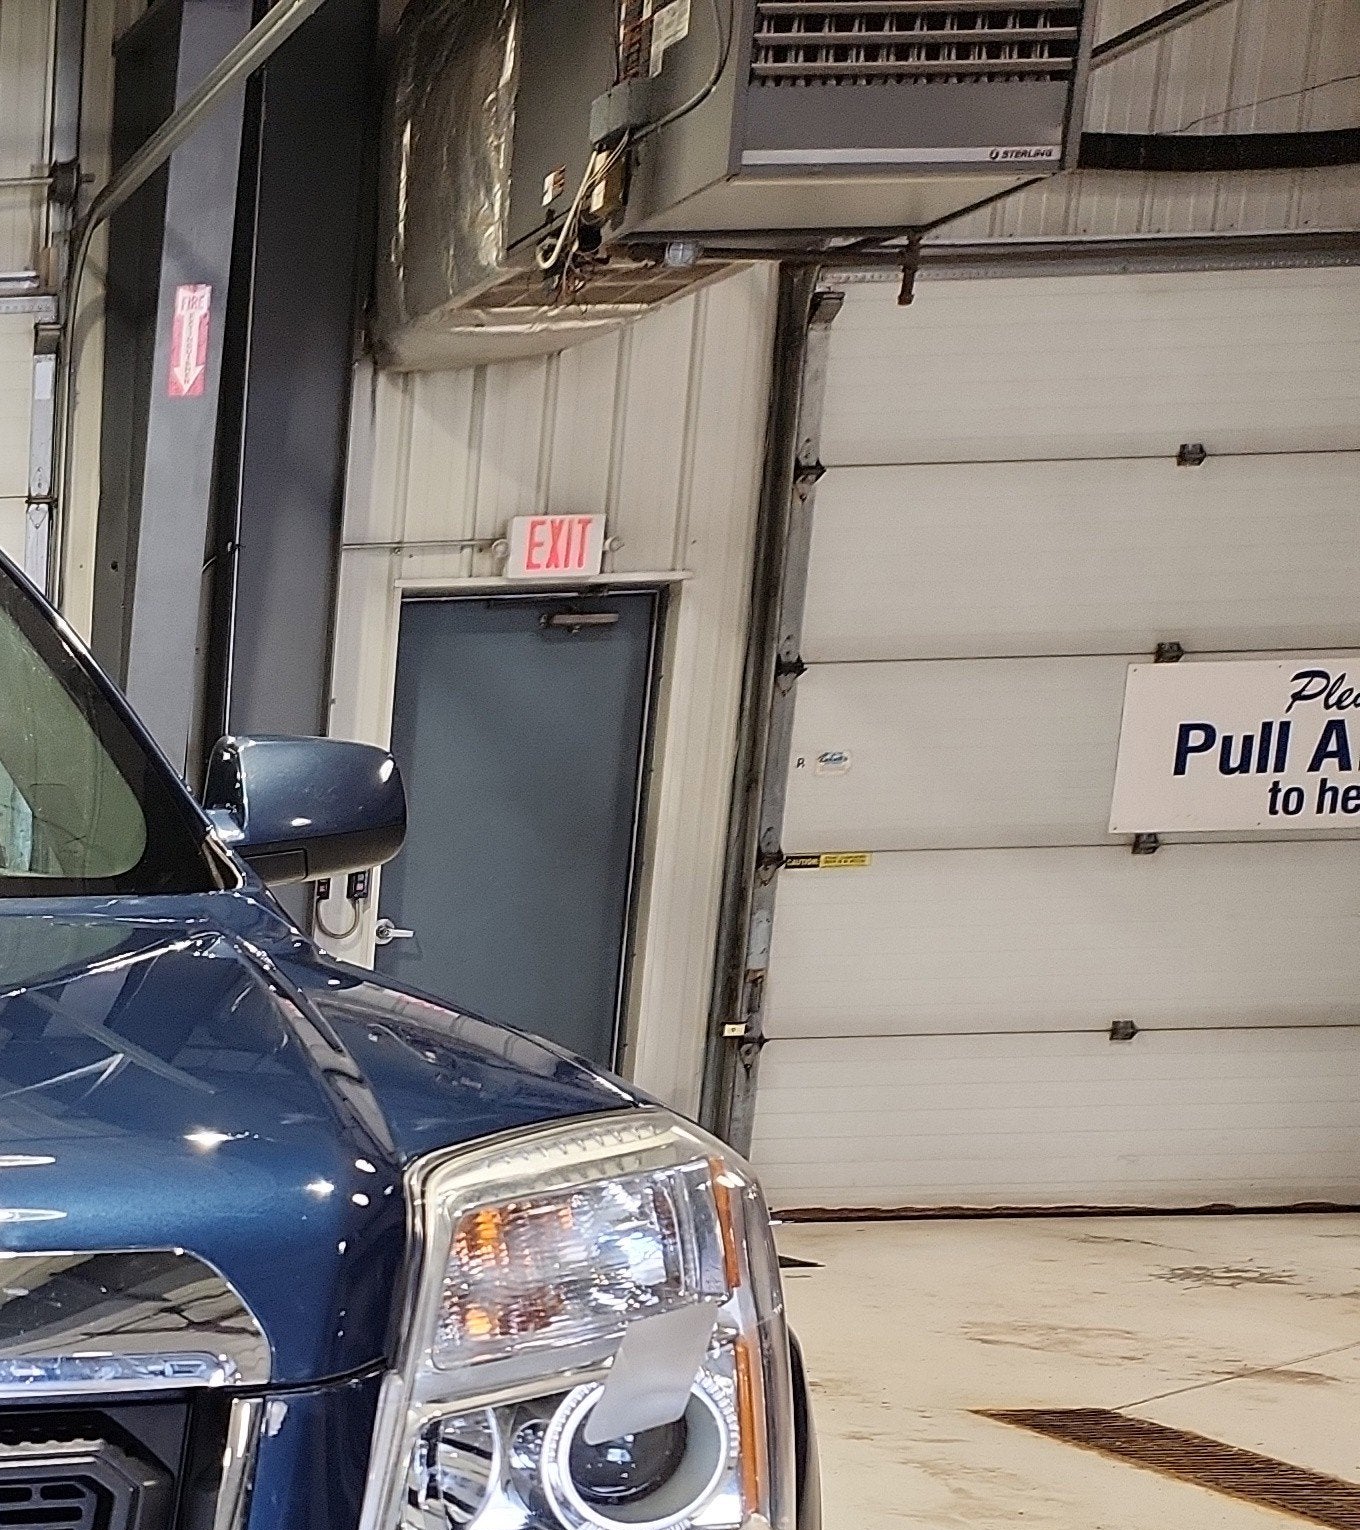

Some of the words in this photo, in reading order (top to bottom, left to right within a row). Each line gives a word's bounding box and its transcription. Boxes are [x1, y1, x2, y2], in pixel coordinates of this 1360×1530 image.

[1001, 149, 1053, 158] STERLING
[181, 295, 205, 311] FIRE
[526, 518, 593, 570] EXIT
[1173, 721, 1291, 776] Pull
[1306, 719, 1360, 772] A
[1268, 781, 1305, 815] to
